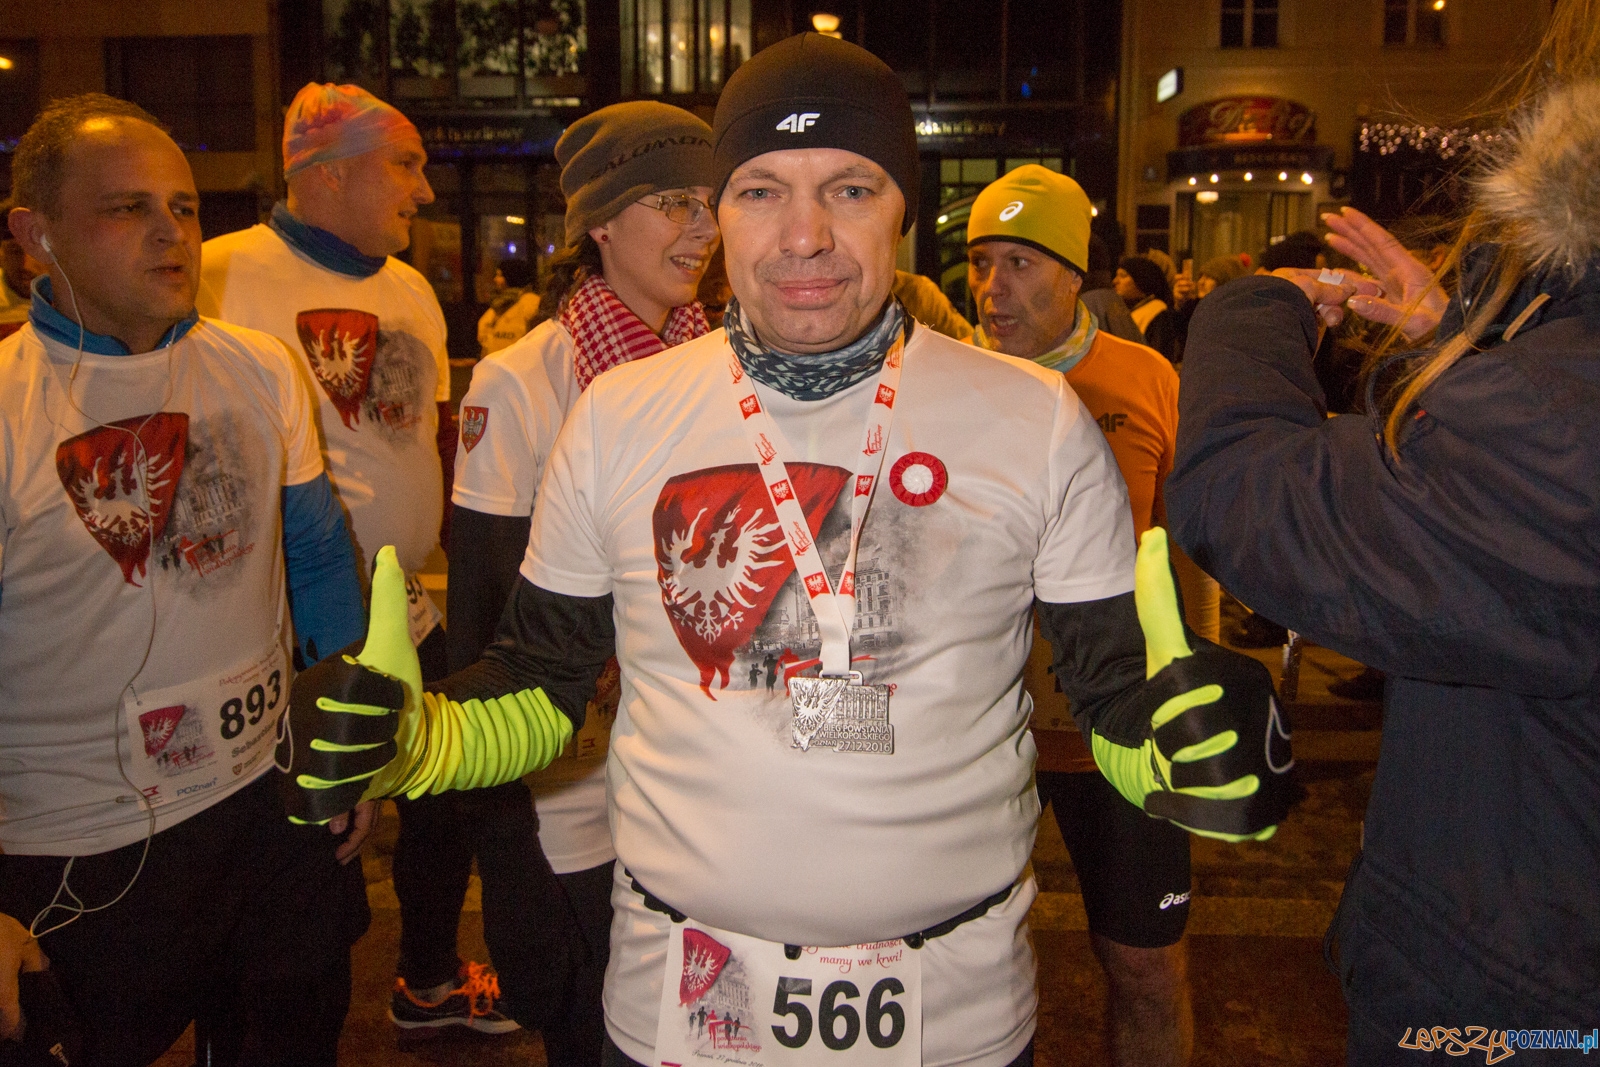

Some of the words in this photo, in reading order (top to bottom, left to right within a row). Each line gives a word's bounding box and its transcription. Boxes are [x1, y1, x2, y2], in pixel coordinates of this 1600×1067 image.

[776, 112, 820, 133] 4F
[220, 669, 281, 740] 893
[819, 731, 891, 741] WIELKOPOLSKIEGO
[823, 723, 841, 732] BIEG
[843, 724, 890, 734] POWSTANIA
[820, 956, 853, 974] mamy
[857, 958, 872, 966] we
[876, 950, 903, 968] krwi!
[771, 976, 905, 1051] 566
